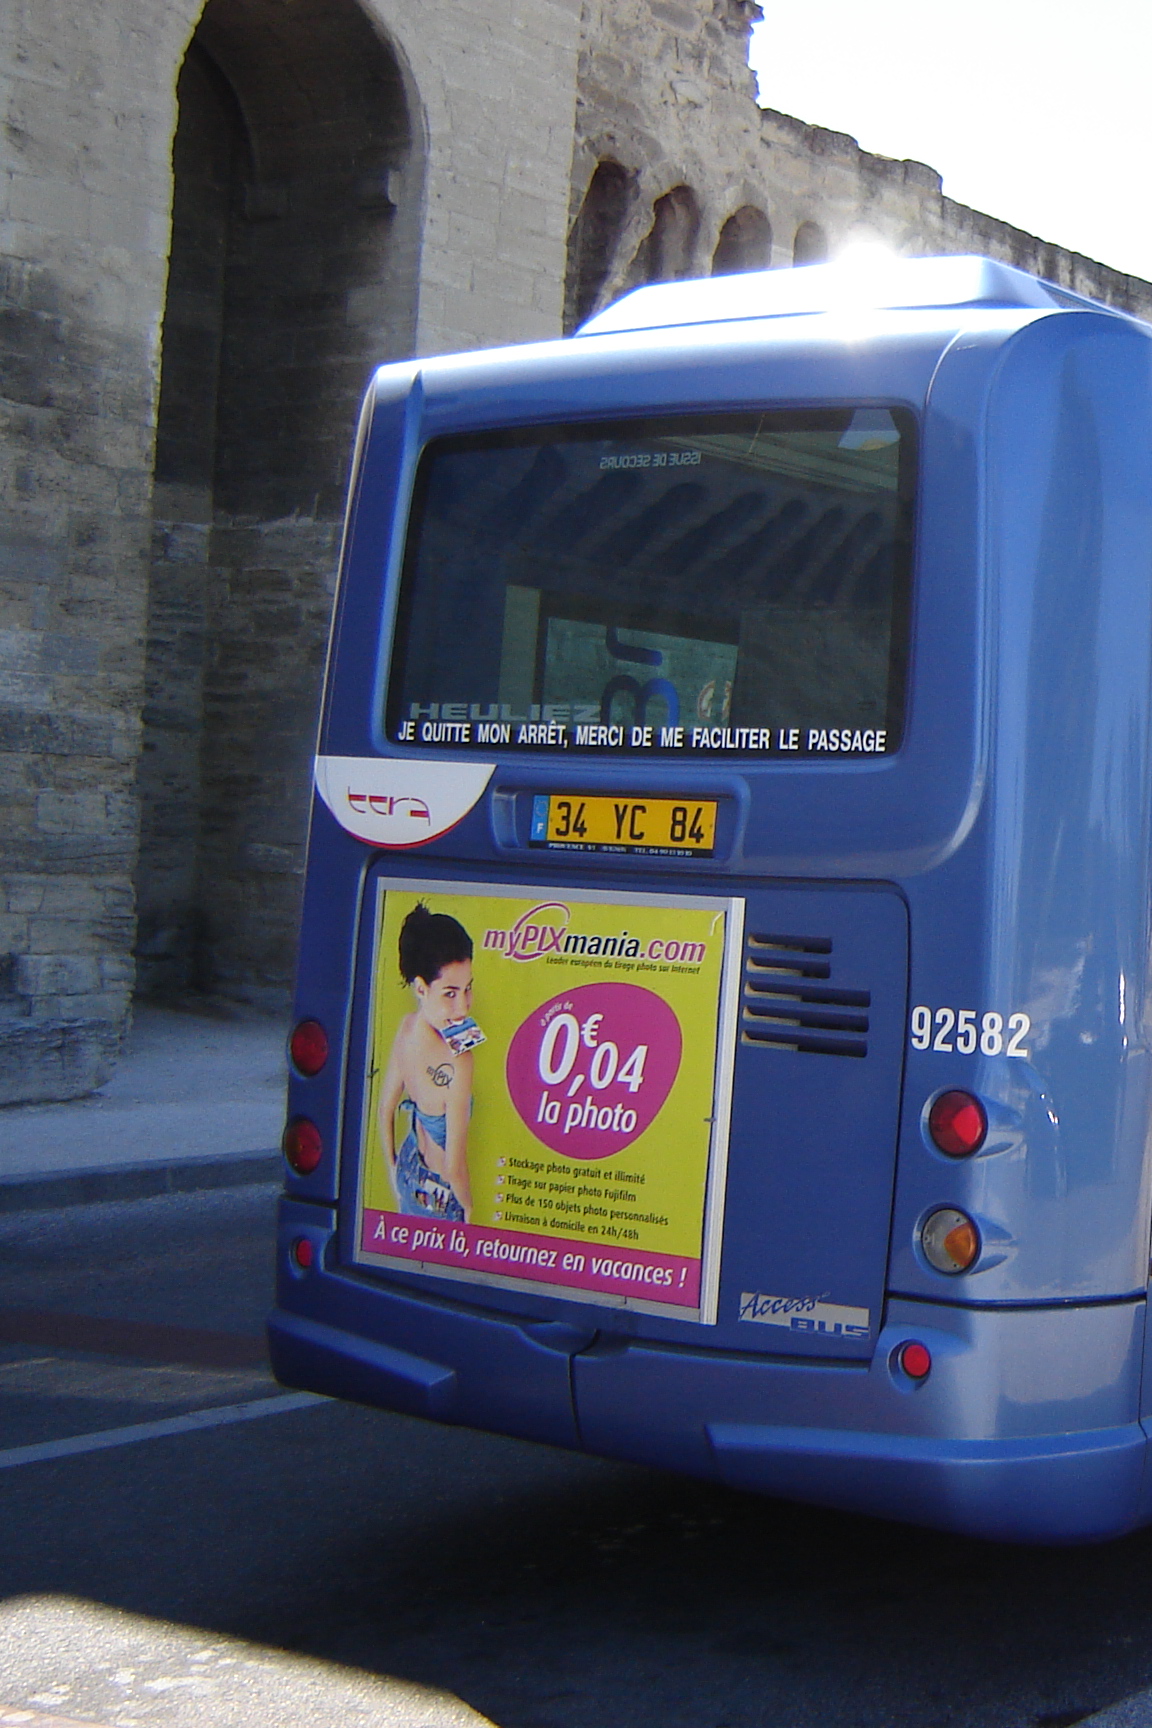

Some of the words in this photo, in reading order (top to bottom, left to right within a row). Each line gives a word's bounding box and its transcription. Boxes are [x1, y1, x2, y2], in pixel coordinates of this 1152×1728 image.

[409, 702, 602, 722] HEULIEZ
[398, 721, 416, 742] JE
[422, 722, 471, 743] QUITTE
[477, 724, 511, 744] MON
[517, 719, 569, 748] ARRÊT,
[575, 725, 624, 747] MERCI
[631, 726, 653, 747] DE
[660, 727, 684, 748] ME
[692, 727, 771, 750] FACILITER
[779, 729, 800, 750] LE
[808, 729, 887, 752] PASSAGE
[536, 823, 545, 834] F
[555, 802, 588, 838] 34
[613, 804, 647, 840] YC
[670, 806, 705, 844] 84
[483, 922, 707, 963] myPIXmania.com
[636, 961, 657, 973] photo
[659, 964, 670, 973] sur
[911, 1005, 1031, 1058] 92582
[538, 1091, 561, 1124] la
[564, 1096, 638, 1133] photo
[509, 1157, 545, 1173] Stockage
[547, 1162, 571, 1175] photo
[573, 1166, 602, 1179] gratuit
[604, 1170, 613, 1181] et
[614, 1169, 646, 1184] illimité
[507, 1175, 532, 1190] Tirage
[534, 1180, 547, 1190] sur
[549, 1182, 575, 1195] papier
[578, 1185, 602, 1198] photo
[604, 1188, 637, 1202] Fujifilm
[506, 1193, 523, 1205] Plus
[525, 1195, 535, 1207] de
[538, 1198, 554, 1209] 150
[556, 1200, 581, 1214] objets
[583, 1203, 608, 1217] photo
[610, 1209, 669, 1226] personnalisés
[505, 1211, 541, 1226] Livraison
[542, 1215, 548, 1227] à
[550, 1217, 585, 1233] domicile
[588, 1224, 599, 1235] en
[601, 1225, 639, 1240] 24h/48h
[374, 1215, 387, 1240] À
[391, 1226, 408, 1243] ce
[412, 1225, 445, 1251] prix
[450, 1229, 470, 1257] là,
[475, 1239, 556, 1268] retournez
[562, 1254, 584, 1272] en
[591, 1256, 673, 1286] vacances
[738, 1290, 823, 1319] Access
[790, 1317, 870, 1340] BUS
